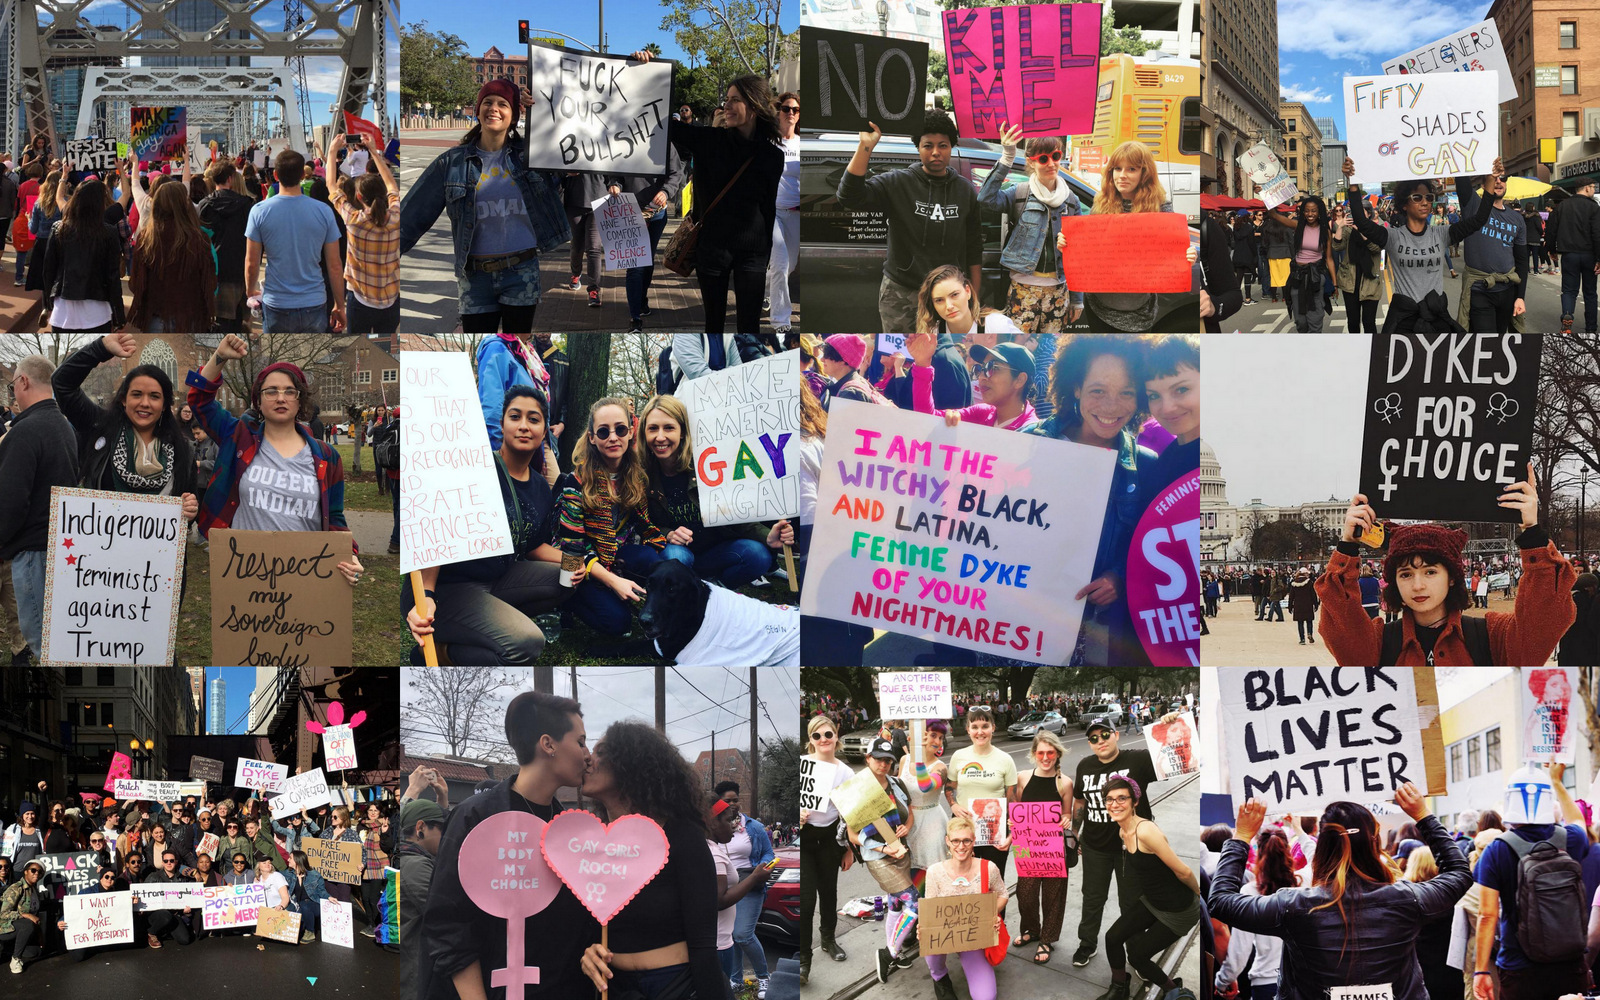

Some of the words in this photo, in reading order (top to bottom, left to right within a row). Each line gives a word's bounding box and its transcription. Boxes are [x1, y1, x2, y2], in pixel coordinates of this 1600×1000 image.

[947, 3, 1096, 75] KILL
[560, 56, 628, 103] FUCK
[817, 39, 917, 121] NO
[1164, 74, 1185, 83] 8429
[969, 67, 1062, 134] ME
[1353, 80, 1425, 113] FIFTY
[132, 107, 180, 126] MAKE
[540, 86, 609, 130] YOUR
[132, 124, 178, 137] AMERICA
[559, 98, 664, 165] BULLSHIT
[1400, 110, 1487, 138] SHADES
[66, 138, 116, 152] RESIST
[135, 135, 164, 155] gay
[1378, 140, 1399, 157] OF
[67, 151, 117, 171] HATE
[1408, 138, 1479, 175] GAY
[1572, 161, 1589, 175] bridal
[603, 204, 637, 220] NEVER
[600, 218, 620, 231] HAVE
[623, 215, 639, 227] THE
[1489, 217, 1518, 234] ECENT
[606, 226, 642, 241] COMFORT
[1481, 226, 1514, 243] HUMAN
[609, 245, 647, 261] SILENCE
[614, 240, 623, 250] OF
[626, 238, 639, 248] OUR
[1397, 243, 1441, 256] DECENT
[616, 258, 638, 269] AGAIN
[1399, 257, 1441, 268] HUMAN
[1386, 333, 1522, 386] DYKES
[406, 367, 449, 388] OUR
[693, 359, 793, 414] MAKE
[424, 395, 468, 418] THAT
[696, 395, 800, 447] AMERIC
[1415, 396, 1476, 438] FOR
[404, 424, 425, 446] IS
[430, 420, 471, 442] OUR
[697, 432, 793, 488] GAY
[854, 428, 882, 457] I
[885, 434, 932, 467] AM
[938, 444, 998, 479] THE
[1378, 438, 1519, 496] CHOICE
[248, 487, 318, 520] INDIAN
[708, 474, 800, 526] AGAI
[837, 460, 950, 507] WITCHY,
[957, 484, 1051, 531] BLACK,
[62, 501, 177, 550] Indigenous
[831, 493, 885, 522] AND
[895, 505, 999, 551] LATINA,
[413, 545, 460, 567] AUDRE
[467, 536, 505, 556] LORDE
[851, 531, 949, 572] FEMME
[959, 553, 1031, 589] DYKE
[222, 536, 335, 589] respect
[75, 554, 161, 593] feminists
[872, 567, 910, 594] OF
[918, 575, 987, 611] YOUR
[68, 596, 151, 628] against
[248, 590, 292, 619] my
[220, 604, 335, 646] sovereign
[851, 591, 1044, 657] NIGHTMARES!
[1138, 602, 1200, 645] THE
[67, 631, 144, 664] Trump
[238, 636, 309, 666] body
[893, 673, 941, 683] ANOTHER
[880, 684, 914, 693] QUEER
[919, 684, 948, 693] FEMME
[1243, 666, 1398, 711] BLACK
[899, 694, 940, 703] AGAINST
[888, 705, 938, 715] FASCISM
[1541, 714, 1560, 722] PLACE
[1244, 703, 1403, 763] LIVES
[1541, 723, 1550, 732] IS
[1552, 723, 1560, 732] IN
[330, 738, 347, 749] OFF
[1542, 733, 1561, 745] THE
[1160, 743, 1189, 754] WOMAN'S
[1167, 749, 1185, 757] PLACE
[244, 760, 263, 768] FEEL
[326, 754, 355, 772] PUSSY
[800, 759, 816, 776] OT
[1170, 762, 1188, 772] THE
[242, 767, 279, 780] DYKE
[1164, 767, 1197, 778] RESISTANCE
[1243, 751, 1414, 805] MATTER
[245, 777, 282, 791] RAGE!
[289, 783, 326, 804] CONNECTED
[274, 798, 285, 811] IS
[1011, 803, 1062, 824] GIRLS
[507, 831, 528, 843] MY
[1012, 826, 1032, 840] just
[320, 840, 341, 851] FREE
[568, 837, 599, 853] GAY
[604, 843, 641, 857] GIRLS
[1026, 838, 1049, 847] have
[307, 848, 351, 863] EDUCATION
[497, 848, 535, 860] BODY
[1011, 845, 1065, 859] FUNDAMENTAL
[320, 859, 339, 869] FREE
[504, 864, 527, 876] MY
[579, 858, 627, 879] ROCK!
[1016, 862, 1063, 871] HUMAN
[490, 878, 539, 890] CHOICE
[80, 898, 83, 910] I
[89, 895, 116, 908] WANT
[205, 894, 265, 911] POSITIVE
[935, 900, 980, 919] HOMOS
[97, 910, 103, 918] A
[942, 916, 980, 929] AGAINST
[73, 934, 89, 944] FOR
[93, 928, 130, 941] PRESIDENT
[929, 926, 979, 949] HATE
